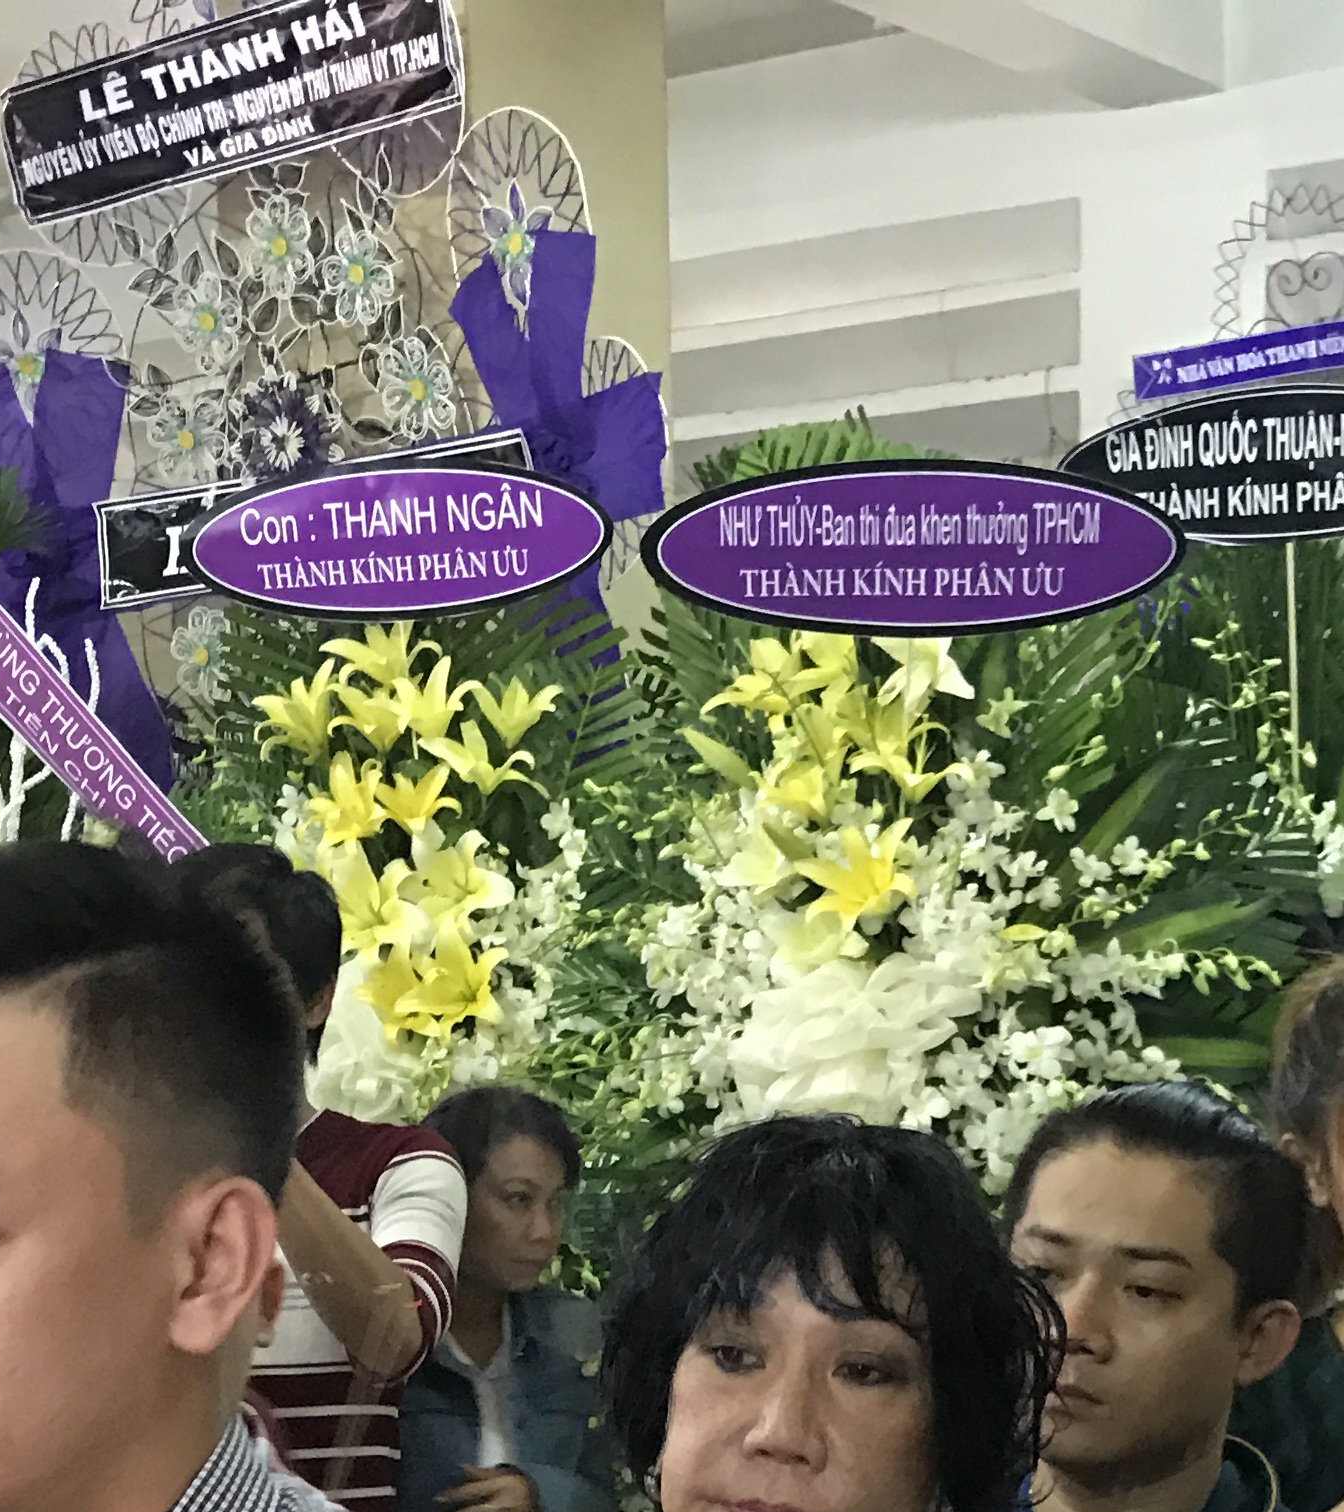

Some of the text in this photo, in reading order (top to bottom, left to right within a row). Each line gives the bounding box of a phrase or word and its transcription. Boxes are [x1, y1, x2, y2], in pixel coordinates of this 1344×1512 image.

[79, 0, 366, 123] LÊ THANH HẢI
[22, 141, 82, 187] NGUYÊN
[79, 129, 102, 170] ỦY
[100, 123, 139, 162] VIÊN
[135, 113, 162, 158] BỘ
[157, 103, 205, 146] CHÍNH
[232, 75, 291, 126] NGUYÊN
[330, 51, 373, 95] THÀNH
[390, 32, 440, 76] TP.HCM
[183, 115, 315, 167] VÀ GIA ĐÌNH
[1106, 431, 1143, 473] GIA
[1144, 418, 1194, 470] ĐÌNH
[1198, 409, 1258, 468] QUỐC
[240, 482, 543, 546] Con : THANH NGÂN
[720, 495, 1101, 556] NHƯ THỦY-Ban thi đua khen thưởng TPHCM
[1227, 477, 1289, 516] KÍNH
[257, 545, 528, 590] THÀNH KÍNH PHÂN ƯU
[739, 560, 1065, 598] THÀNH KÍNH PHÂN ƯU
[41, 690, 137, 810] THƯƠNG
